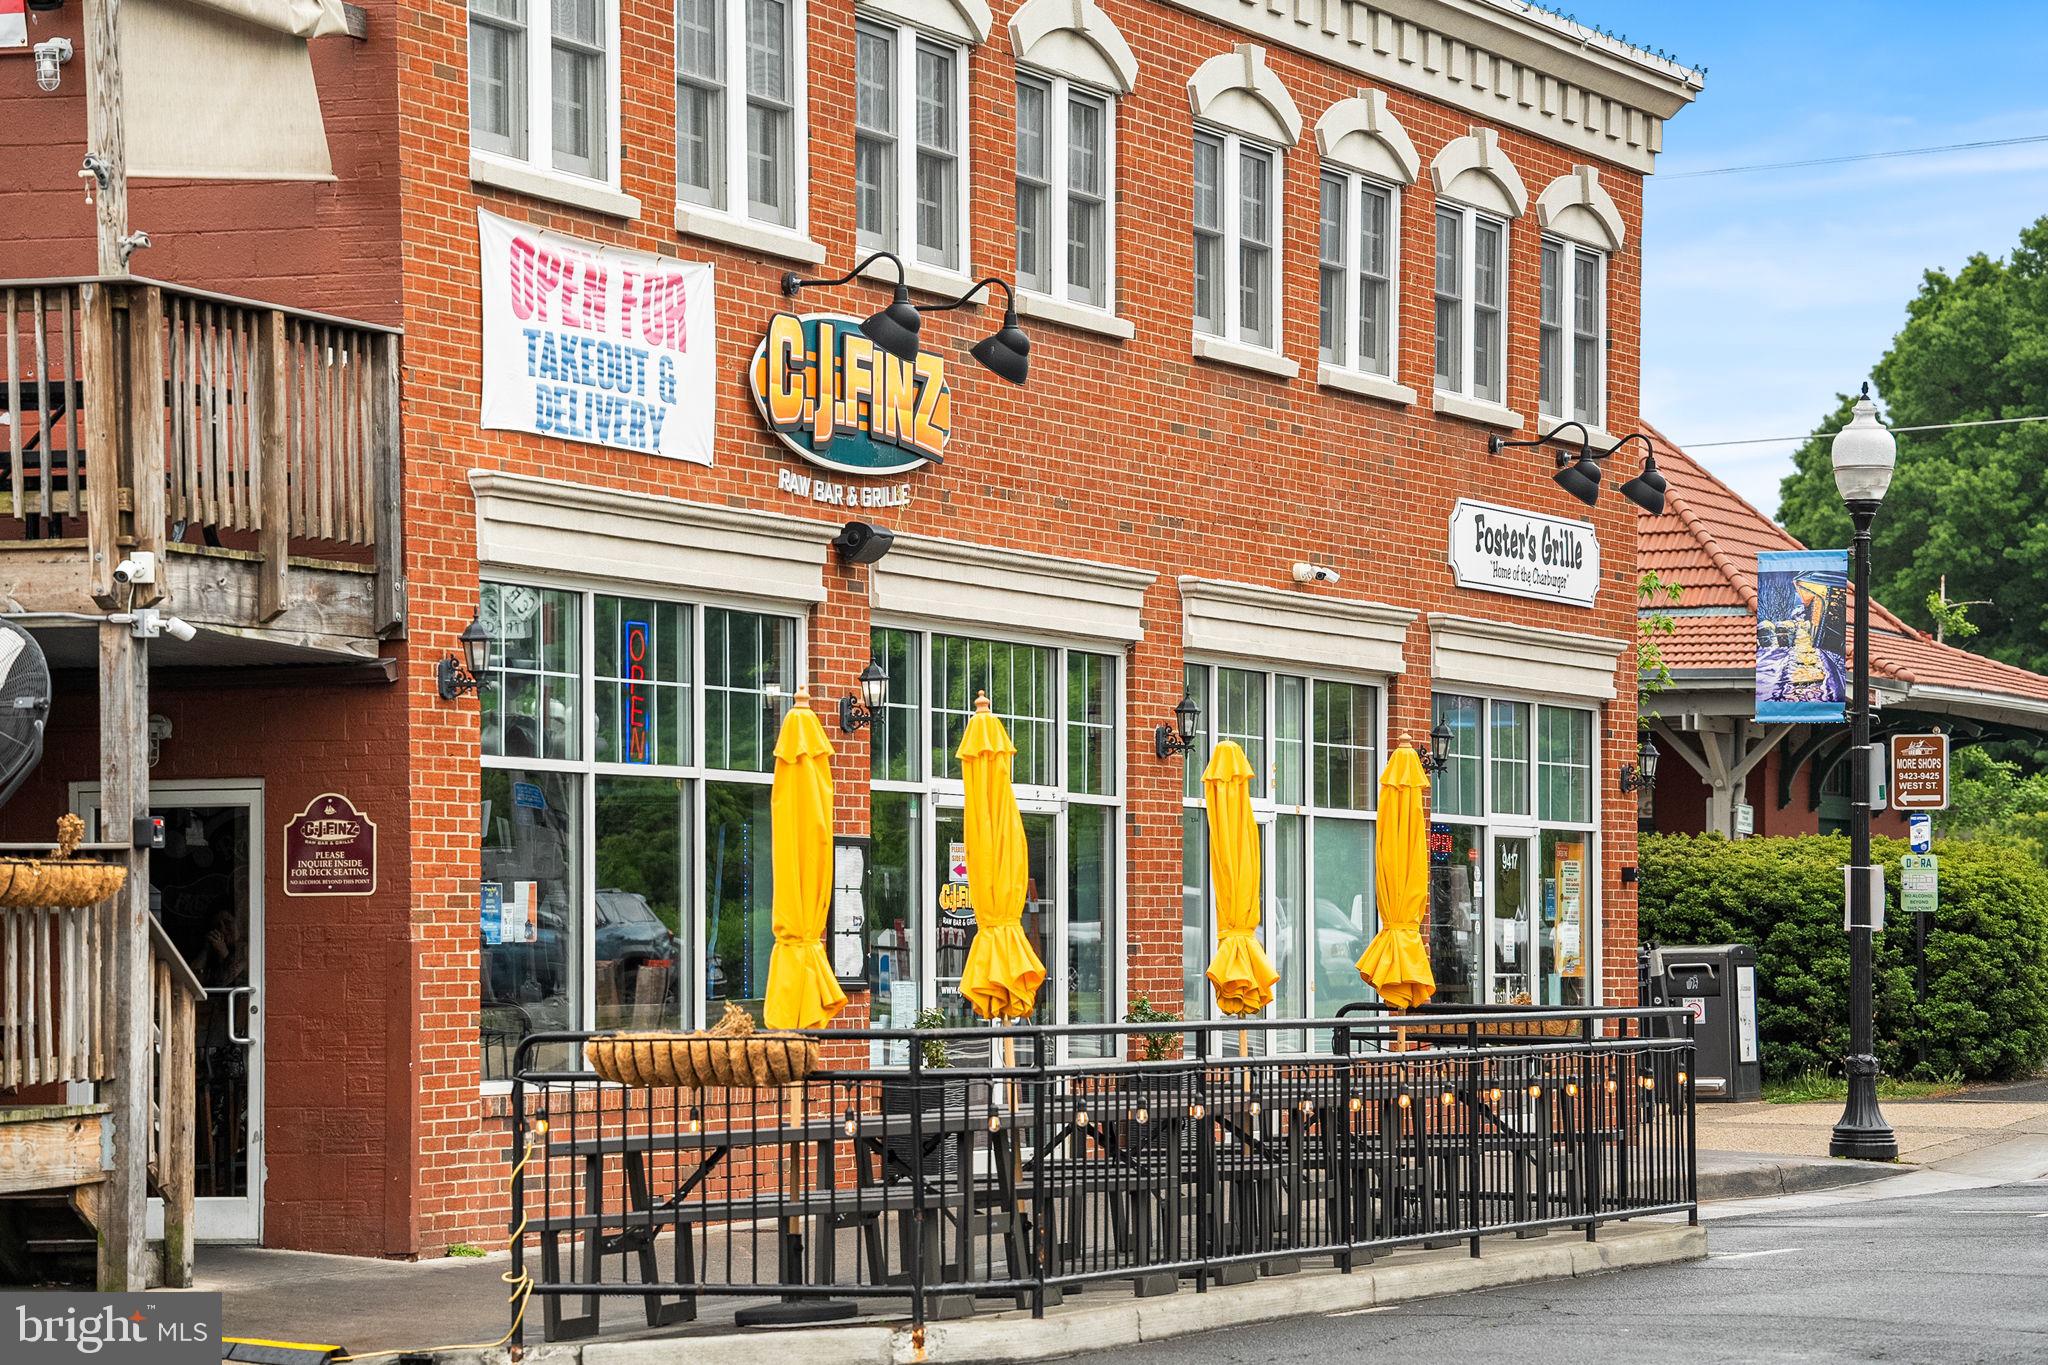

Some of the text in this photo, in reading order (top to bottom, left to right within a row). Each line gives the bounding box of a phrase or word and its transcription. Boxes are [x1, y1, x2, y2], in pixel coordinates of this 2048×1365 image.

[509, 235, 687, 353] OPEN FOR
[523, 328, 677, 405] TAKEOUT &
[535, 383, 667, 451] DELIVERY
[778, 468, 910, 508] RAW BAR & GRILLE
[1475, 514, 1583, 570] Foster's Grille
[1512, 564, 1520, 581] of
[1520, 566, 1531, 582] the
[630, 629, 646, 760] OPEN
[1896, 758, 1942, 770] MORE SHOPS
[1898, 772, 1940, 780] 9423-9425
[1898, 781, 1938, 790] WEST ST.
[298, 860, 363, 868] INQUIRE INSIDE
[1502, 853, 1518, 871] 9417
[309, 868, 332, 876] DECK
[333, 868, 369, 876] SEATING
